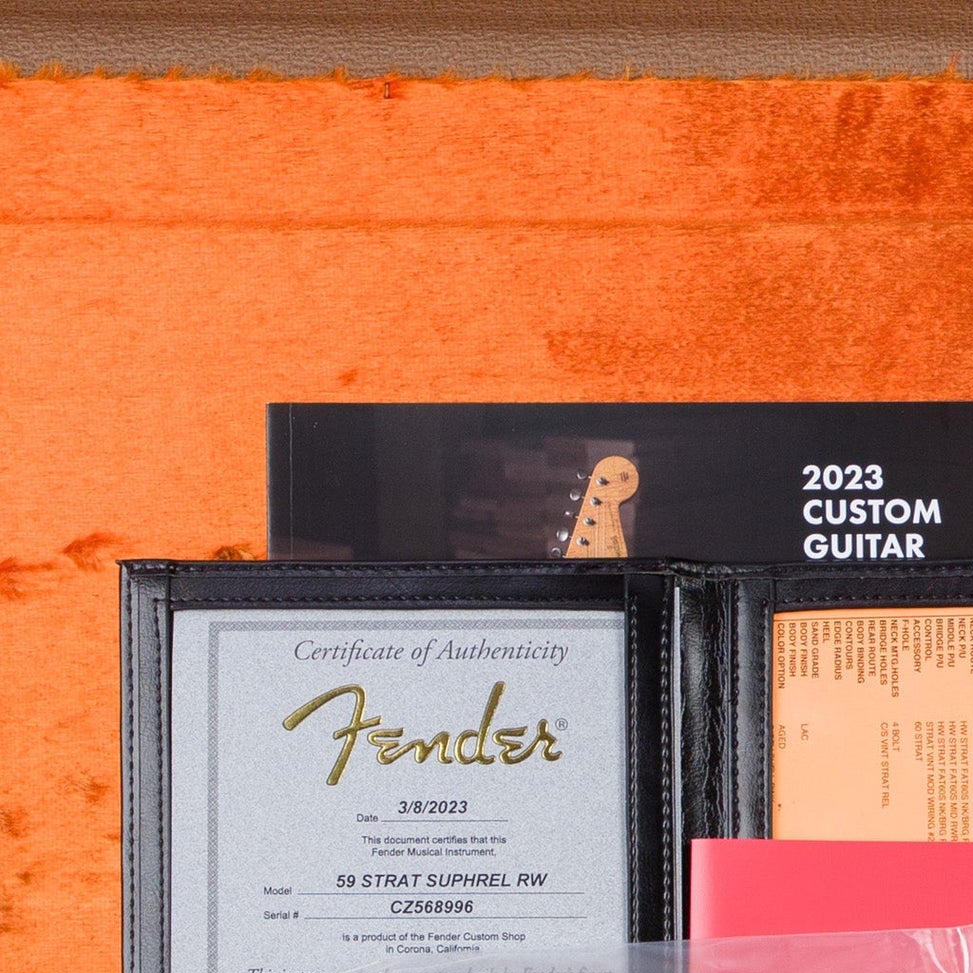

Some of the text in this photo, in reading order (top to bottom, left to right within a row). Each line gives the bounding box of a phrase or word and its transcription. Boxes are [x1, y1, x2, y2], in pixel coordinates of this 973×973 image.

[802, 465, 884, 490] 2023
[802, 499, 942, 525] CUSTOM
[802, 533, 925, 559] GUITAR
[811, 621, 819, 645] SAND
[294, 639, 568, 667] Certificate of Authenticity
[913, 619, 921, 673] ACCESSORY
[834, 647, 842, 680] RADIUS
[857, 647, 865, 684] BINDING
[880, 655, 888, 686] HOLES
[936, 654, 944, 668] P/U
[282, 681, 562, 786] Fender
[357, 800, 468, 822] Date 3/8/2023
[362, 836, 506, 844] This document certifies that this
[372, 848, 497, 856] Fender Musical Instrument,
[264, 873, 548, 895] Model 59 STRAT SUPHREL RW
[264, 911, 290, 919] Serial
[390, 901, 474, 913] CZ568996
[343, 933, 350, 941] is
[362, 933, 396, 942] product
[399, 933, 408, 941] of
[411, 933, 425, 941] the
[428, 933, 461, 941] Fender
[463, 933, 499, 941] Custom
[502, 932, 526, 942] Shop
[386, 945, 480, 954] in Corona, California
